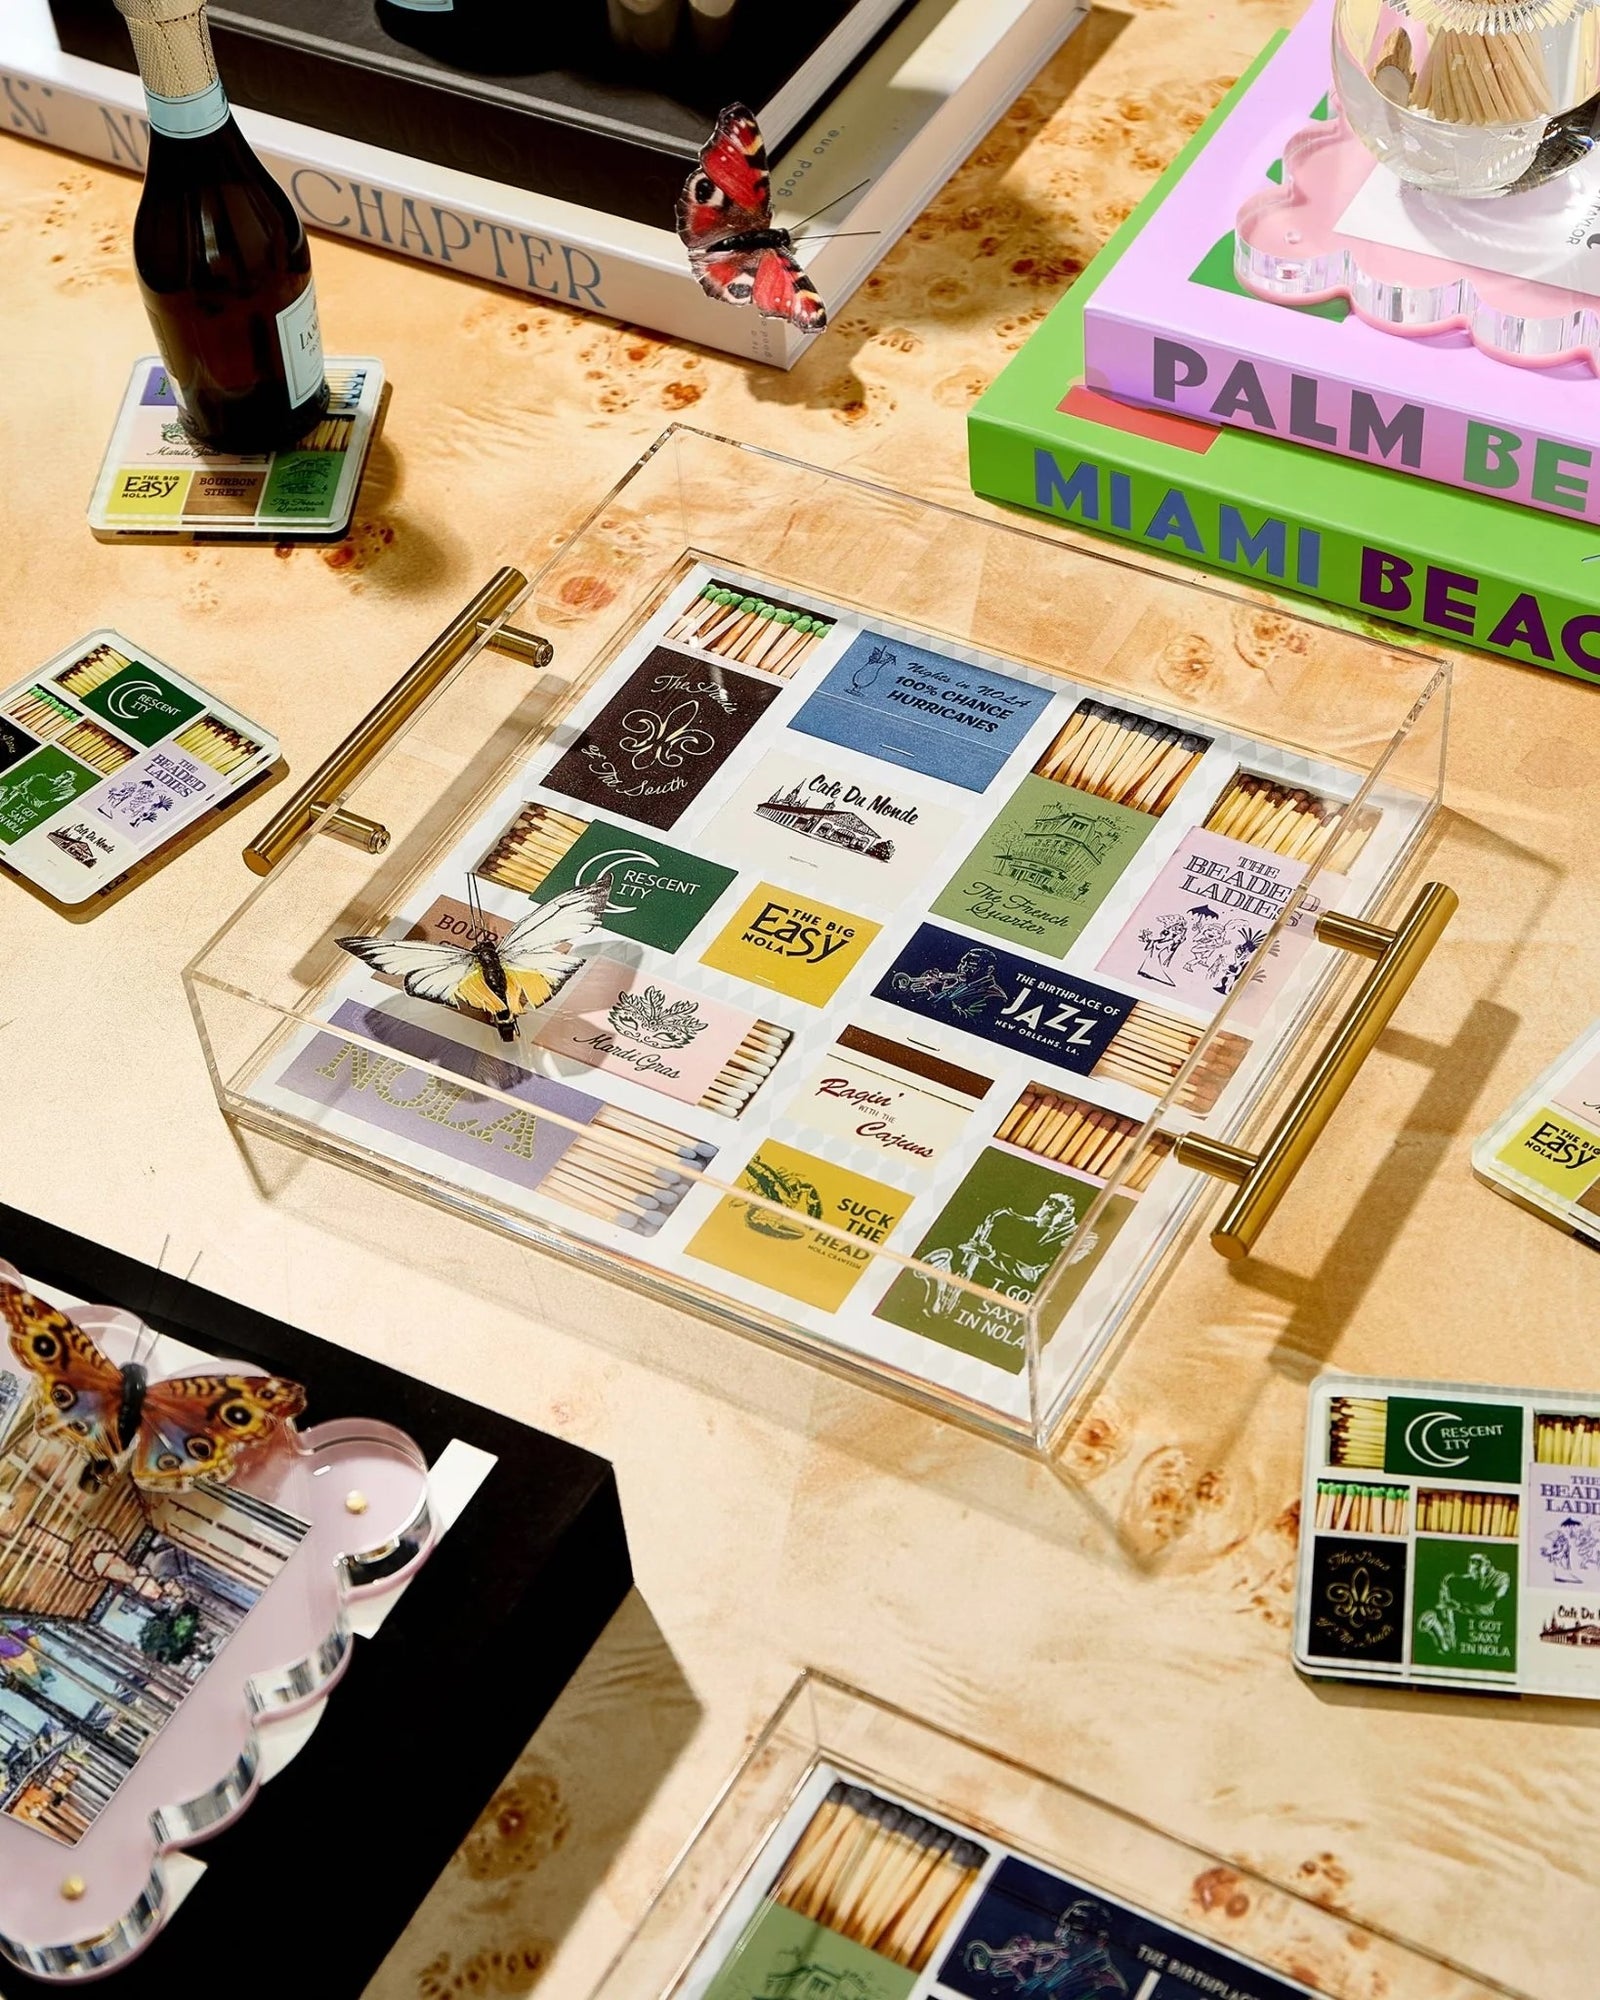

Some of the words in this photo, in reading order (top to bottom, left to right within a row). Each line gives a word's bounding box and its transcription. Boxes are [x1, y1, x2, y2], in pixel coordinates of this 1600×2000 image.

[777, 159, 813, 197] good
[813, 125, 846, 155] one.
[291, 168, 606, 308] CHAPTER
[1152, 336, 1425, 468] PALM
[1463, 419, 1593, 513] BE
[123, 476, 179, 497] Easy
[199, 477, 257, 487] BOURBON
[203, 488, 246, 497] STREET
[1034, 448, 1320, 588] MIAMI
[1360, 546, 1600, 676] BEAC
[650, 673, 690, 693] The
[896, 676, 938, 697] 100%
[941, 690, 1015, 720] CHANCE
[907, 662, 951, 685] Nights
[955, 680, 970, 689] in
[977, 684, 1032, 708] NOLA
[886, 690, 999, 733] HURRICANES
[144, 763, 193, 798] LADIES
[151, 753, 207, 792] BEADED
[178, 758, 199, 773] THE
[581, 744, 605, 766] of
[616, 776, 689, 797] South
[22, 807, 39, 820] GOT
[808, 774, 843, 799] Café
[842, 785, 867, 808] Du
[866, 795, 919, 826] Monde
[6, 817, 24, 835] NOLA
[1236, 855, 1281, 879] THE
[963, 881, 1002, 903] The
[1002, 895, 1070, 928] French
[965, 901, 1046, 935] Quarter
[748, 901, 849, 964] Easy
[791, 908, 820, 926] THE
[824, 920, 855, 938] BIG
[740, 932, 785, 955] NOLA
[1015, 973, 1037, 986] THE
[1036, 981, 1102, 1010] BIRTHPLACE
[1103, 1005, 1121, 1017] OF
[994, 1019, 1016, 1031] NEW
[1000, 987, 1098, 1046] JAZZ
[573, 1033, 634, 1065] Mardi
[633, 1052, 681, 1080] Gras
[314, 1041, 539, 1161] NOLA
[814, 1078, 905, 1106] Ragin'
[858, 1104, 880, 1117] WITH
[881, 1112, 897, 1124] THE
[856, 1121, 934, 1158] Cajuns
[1524, 1140, 1553, 1160] NOLA
[1530, 1121, 1597, 1170] Easy
[1560, 1128, 1581, 1144] THE
[837, 1197, 895, 1229] SUCK
[845, 1217, 885, 1244] THE
[814, 1232, 870, 1260] HEAD
[988, 1277, 1005, 1293] I
[977, 1300, 1023, 1327] SAXY
[954, 1308, 981, 1330] IN
[980, 1320, 1027, 1350] NOLA
[1468, 1619, 1476, 1630] I
[1477, 1619, 1505, 1633] GOT
[1581, 1607, 1595, 1620] Du
[1459, 1642, 1476, 1656] IN
[1476, 1644, 1512, 1658] NOLA
[1468, 1631, 1502, 1645] SAXY
